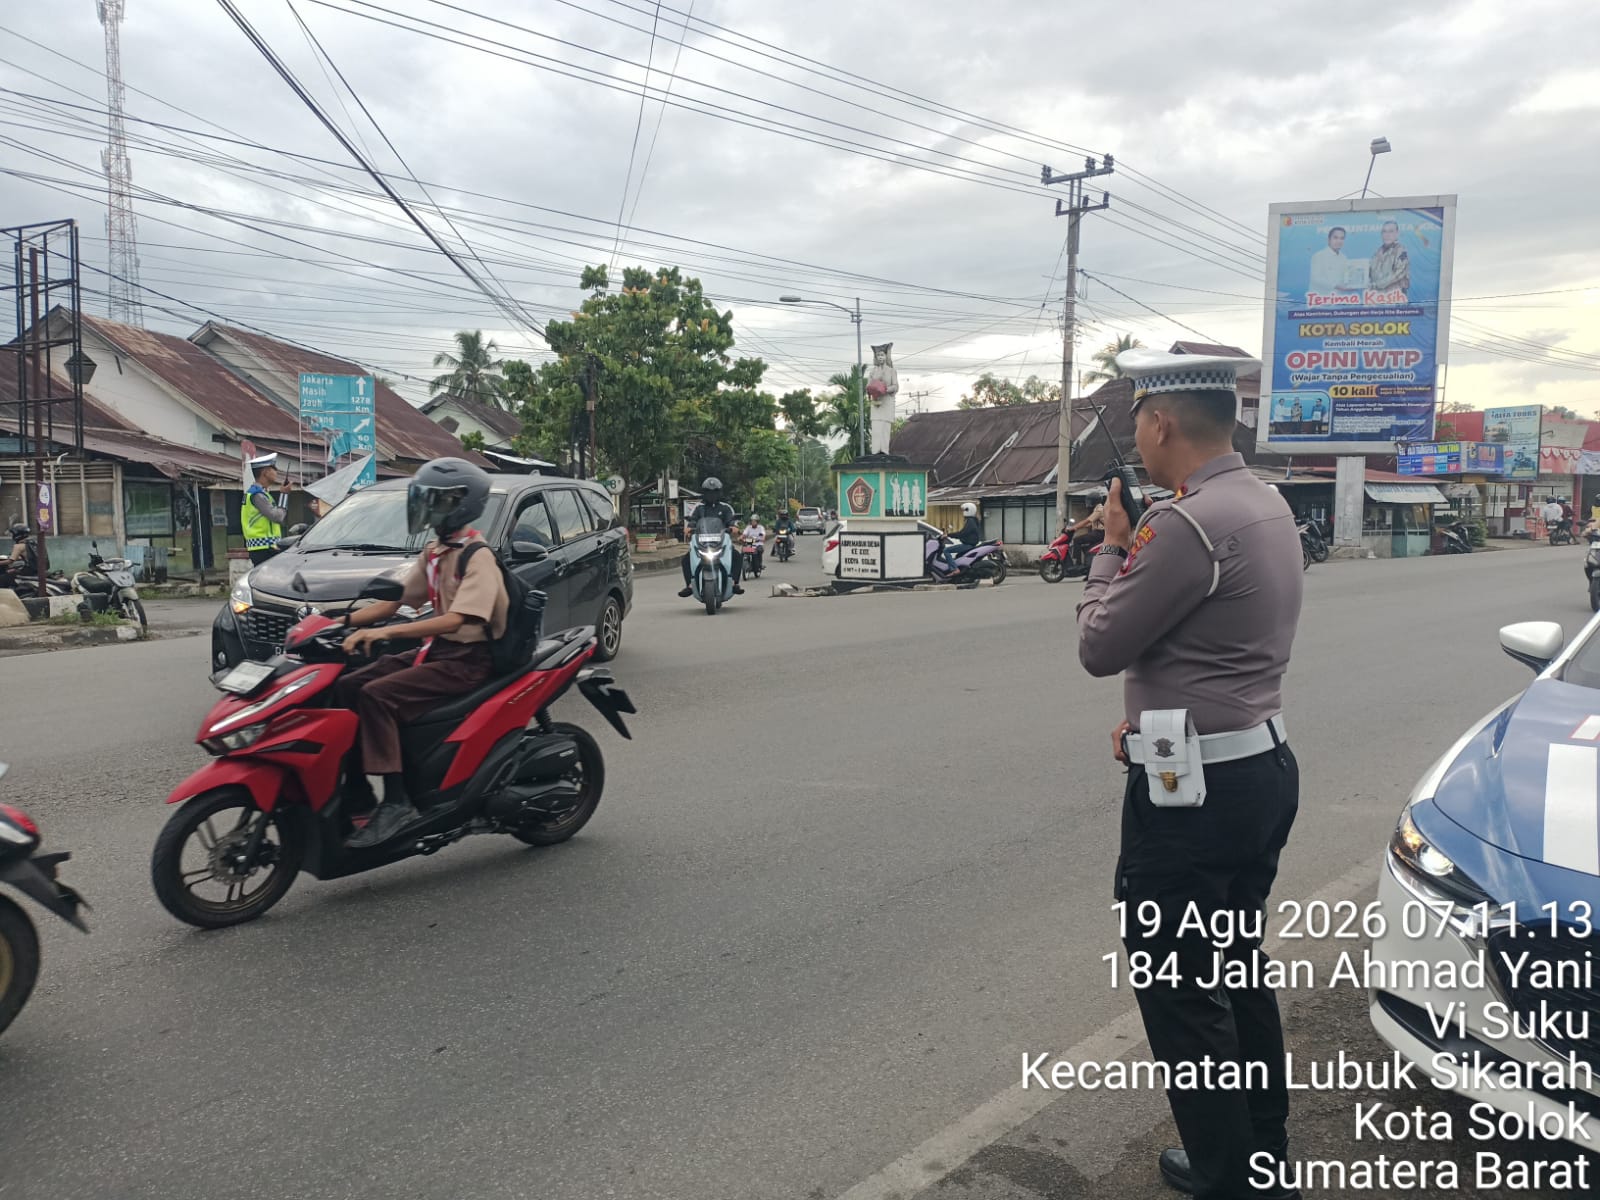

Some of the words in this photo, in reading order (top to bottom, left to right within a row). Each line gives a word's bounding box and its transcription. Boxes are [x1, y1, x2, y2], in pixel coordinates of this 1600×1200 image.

[1307, 292, 1359, 306] Terima
[1364, 290, 1408, 304] Kasih
[1300, 322, 1346, 338] KOTA
[1349, 322, 1410, 336] SOLOK
[1287, 351, 1356, 369] OPINI
[1364, 350, 1420, 368] WTP
[303, 375, 333, 385] Jakarta
[1292, 374, 1321, 382] (Wajar
[1322, 374, 1348, 382] Tanpa
[1350, 372, 1414, 382] Pengecualian)
[302, 387, 326, 396] Masih
[1333, 386, 1348, 396] 10
[1351, 386, 1374, 396] kali
[303, 399, 322, 407] Jauh
